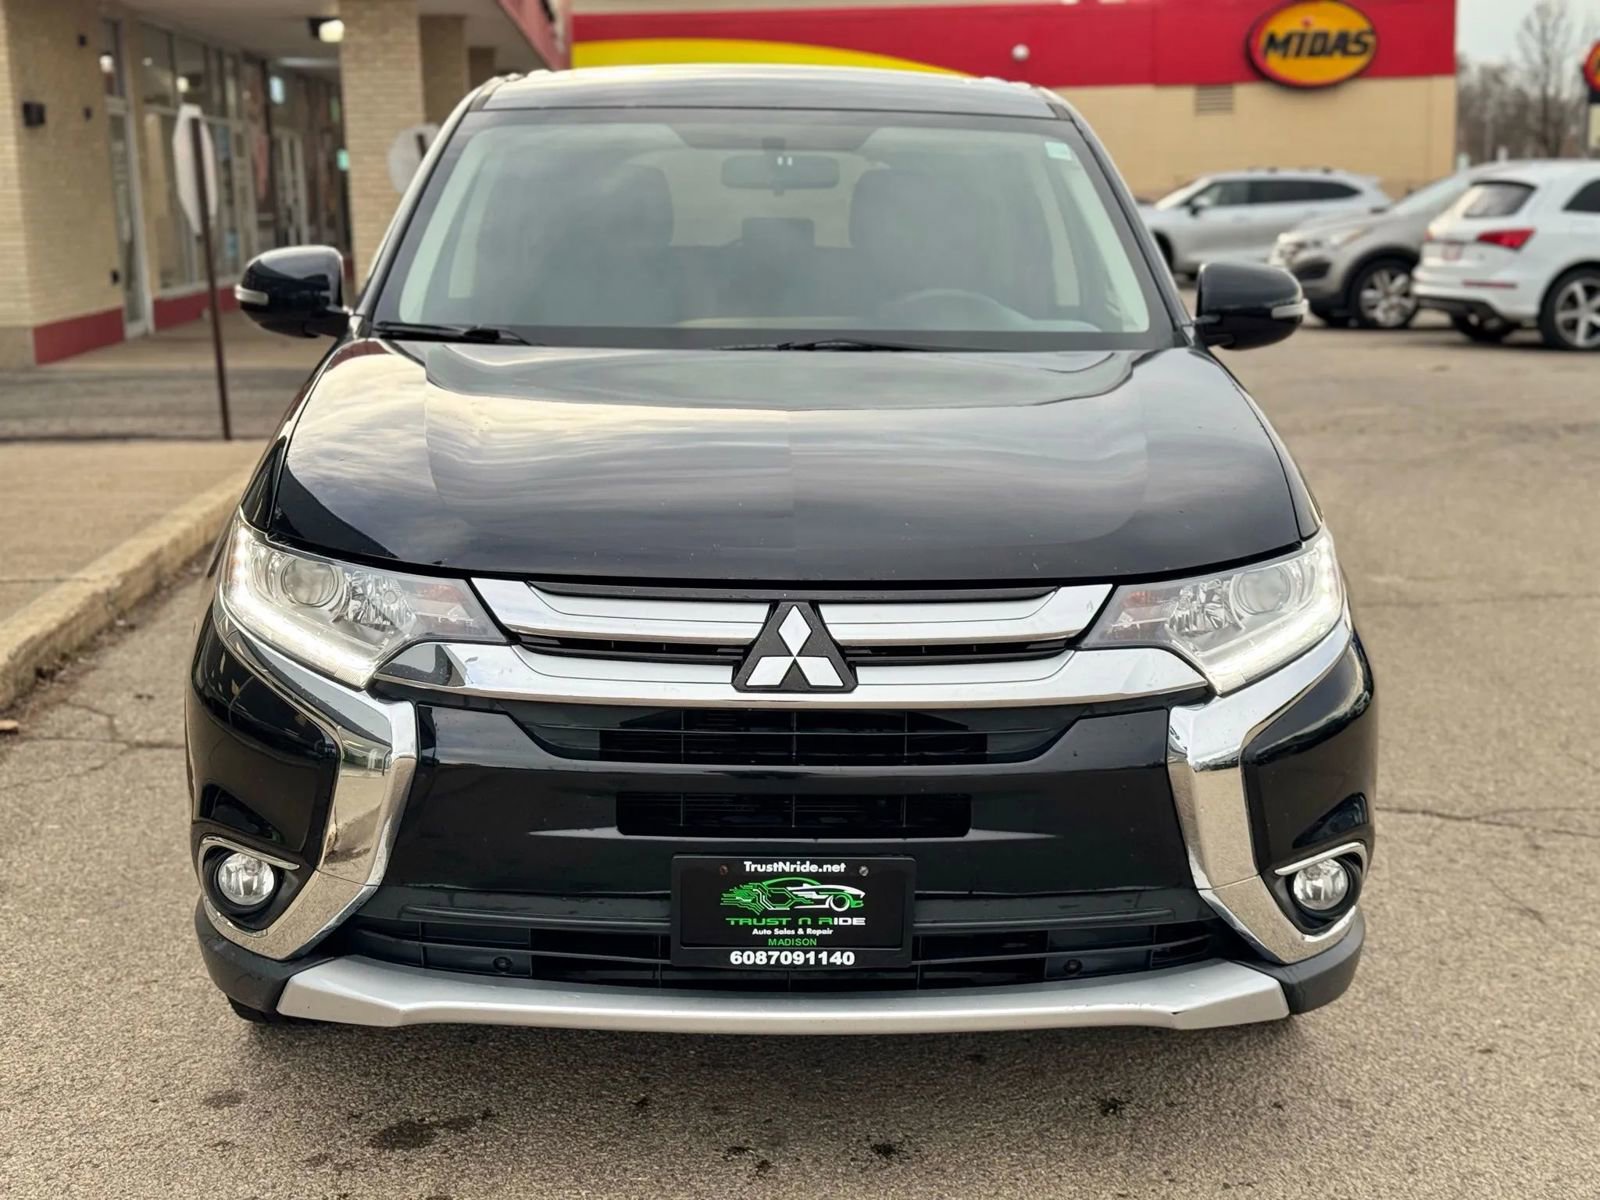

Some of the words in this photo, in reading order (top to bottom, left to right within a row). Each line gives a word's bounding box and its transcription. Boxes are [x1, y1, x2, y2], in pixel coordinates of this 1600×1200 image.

[743, 861, 846, 873] TrustNride.net
[725, 917, 792, 926] TRUST
[818, 917, 866, 926] RIDE
[752, 928, 772, 936] Auto
[774, 928, 795, 936] Sales
[797, 928, 805, 936] &
[806, 928, 834, 937] Repair
[768, 937, 817, 946] MADISON
[729, 950, 856, 966] 6087091140
